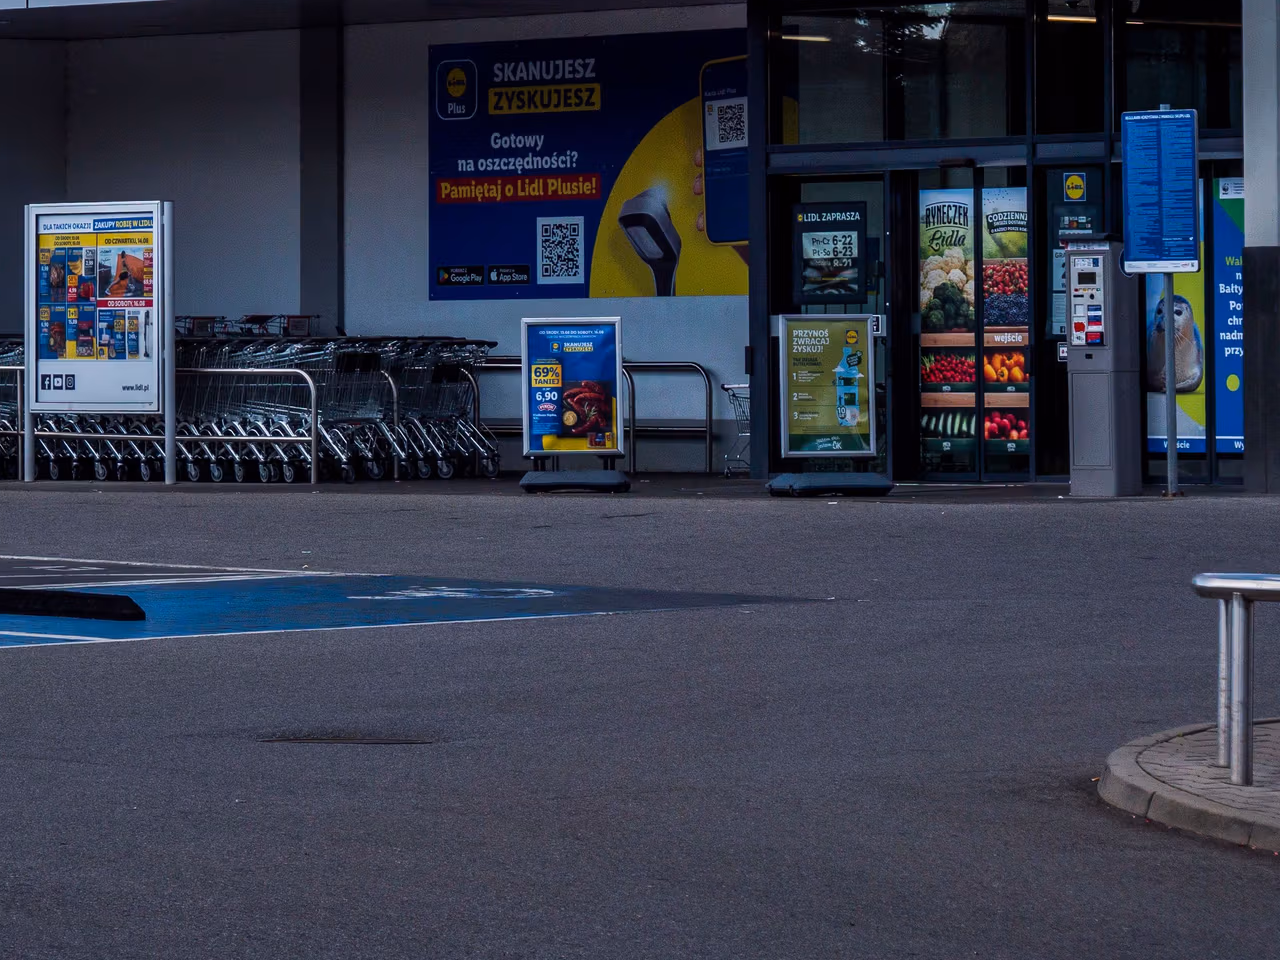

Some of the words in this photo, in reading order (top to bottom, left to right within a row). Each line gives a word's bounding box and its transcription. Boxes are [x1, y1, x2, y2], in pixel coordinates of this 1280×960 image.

[493, 58, 596, 82] SKANUJESZ
[493, 87, 596, 110] ZYSKUJESZ
[447, 102, 466, 114] Plus
[490, 132, 544, 151] Gotowy
[458, 158, 475, 171] na
[478, 150, 578, 174] oszczędności?
[440, 179, 501, 202] Pamiętaj
[504, 184, 513, 196] o
[517, 178, 544, 197] Lidl
[547, 176, 596, 196] Plusie!
[803, 213, 821, 222] LIDL
[822, 212, 861, 221] ZAPRASZA
[925, 203, 969, 229] RYNECZEK
[53, 222, 72, 230] TAKICH
[94, 220, 115, 229] ZAKUPY
[116, 219, 132, 229] ROBIĘ
[133, 219, 138, 227] W
[112, 237, 137, 246] CZWARTKU,
[832, 235, 853, 246] 6-22
[928, 229, 967, 252] Lidla
[832, 246, 853, 257] 6-23
[450, 273, 471, 283] Google
[470, 272, 482, 283] Play
[499, 273, 511, 283] App
[511, 272, 528, 282] Store
[792, 328, 829, 337] PRZYNOŚ
[993, 332, 1023, 344] wejście
[792, 337, 830, 345] ZWRACAJ
[792, 345, 824, 353] ZYSKUJ!
[534, 367, 560, 378] 69%
[793, 372, 798, 381] 1
[122, 384, 150, 392] www.lidl.pl
[536, 391, 558, 402] 6,90
[793, 393, 798, 401] 2
[793, 411, 798, 420] 3
